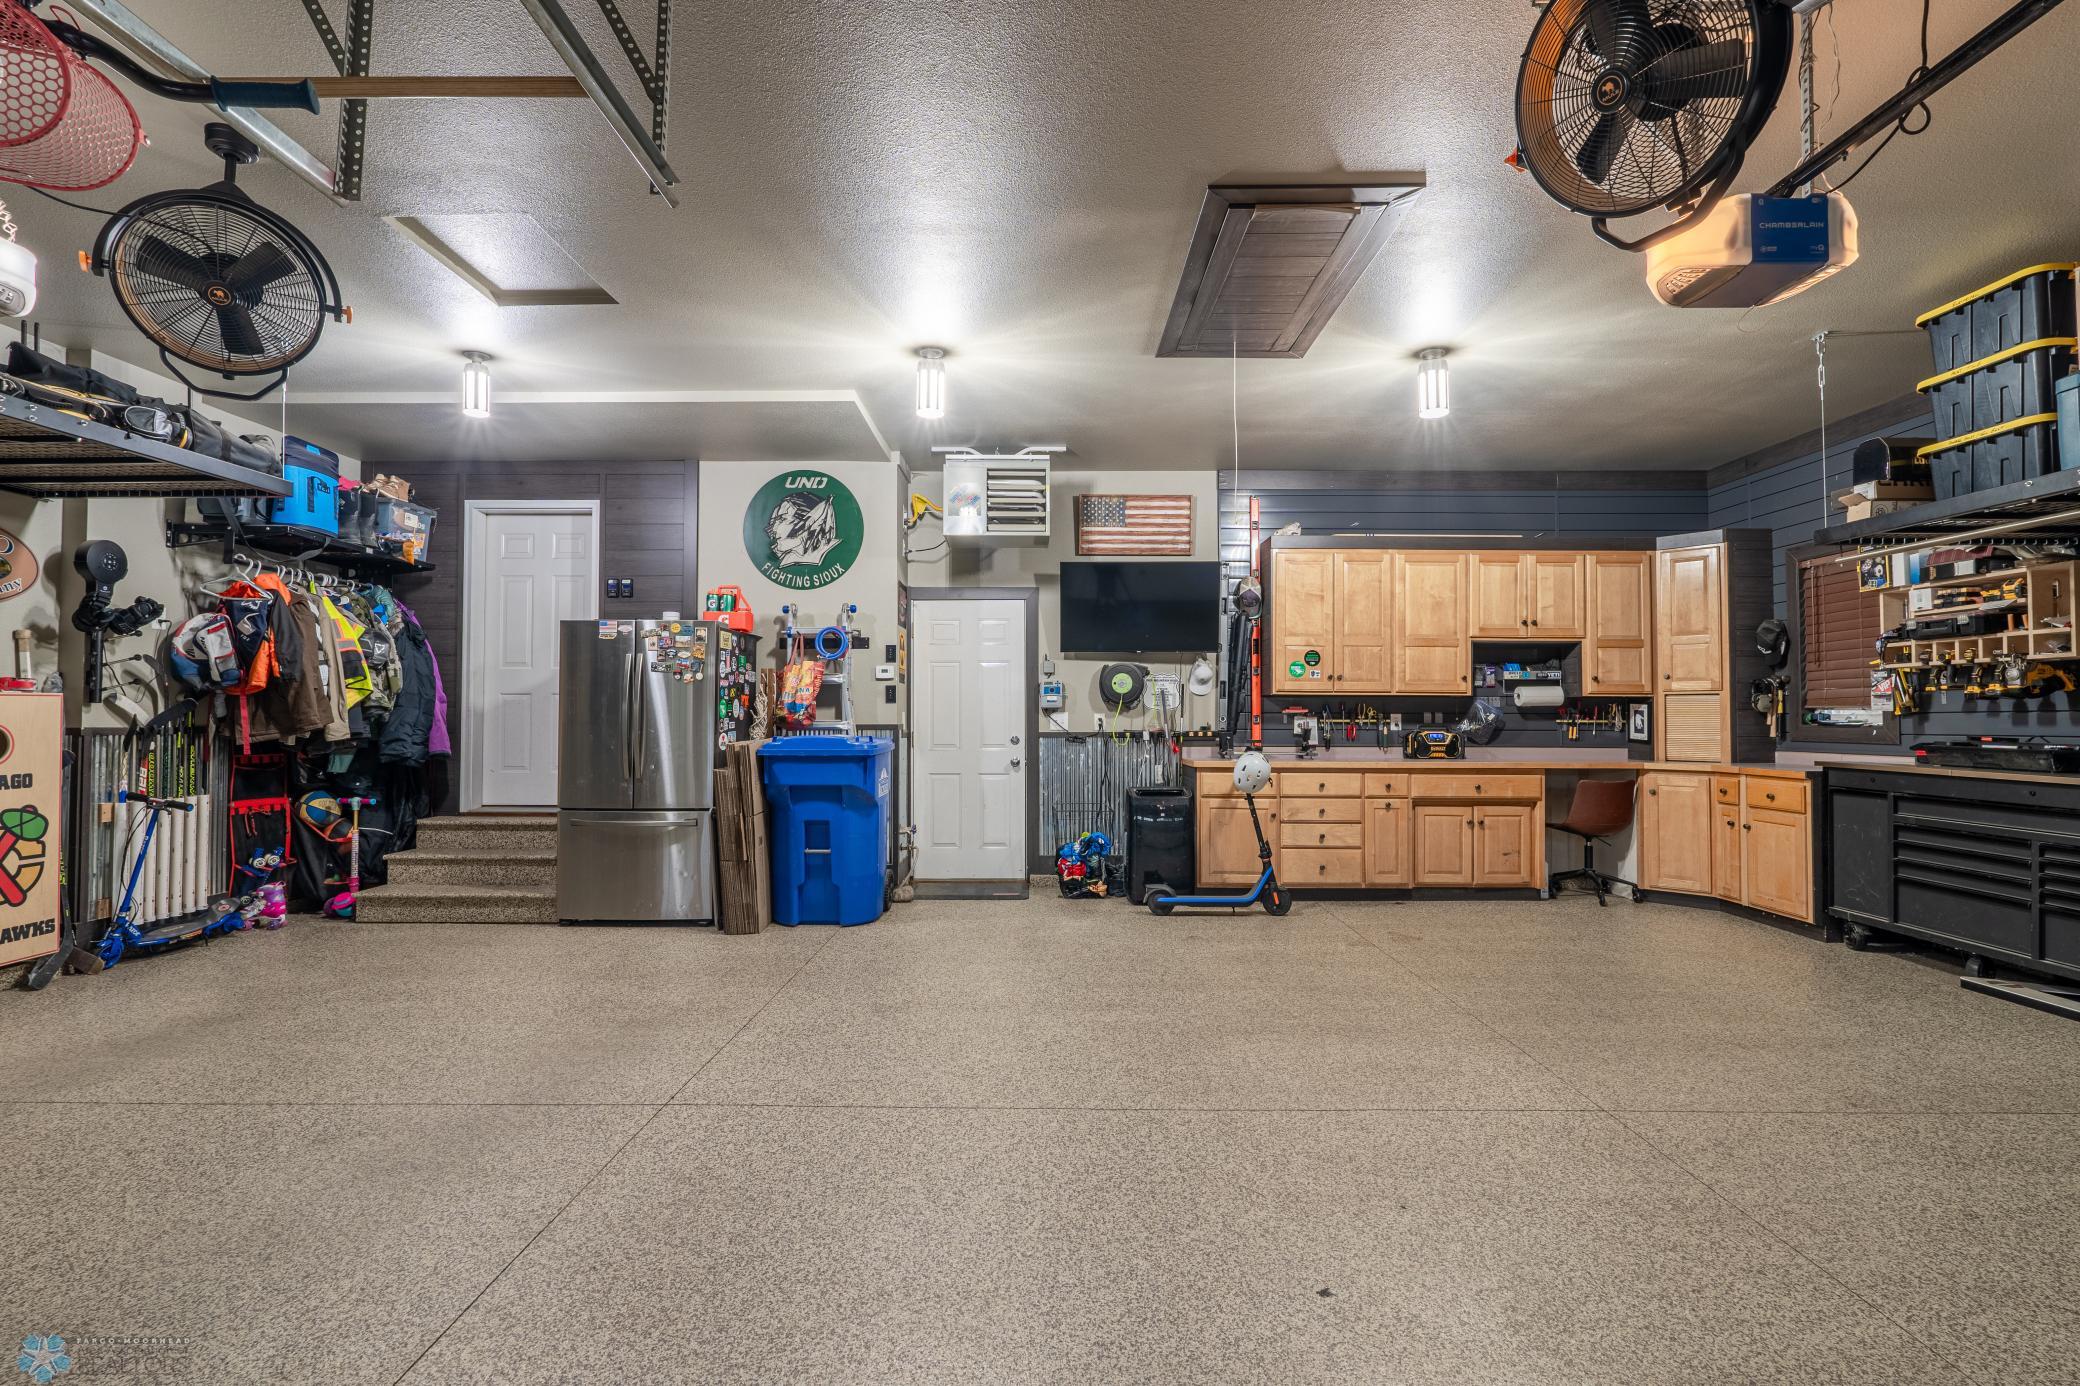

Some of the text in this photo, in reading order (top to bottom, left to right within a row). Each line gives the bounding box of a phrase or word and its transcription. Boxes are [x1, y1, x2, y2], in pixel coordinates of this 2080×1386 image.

[784, 476, 829, 489] UND
[761, 562, 846, 588] FIGHTING SIOUX
